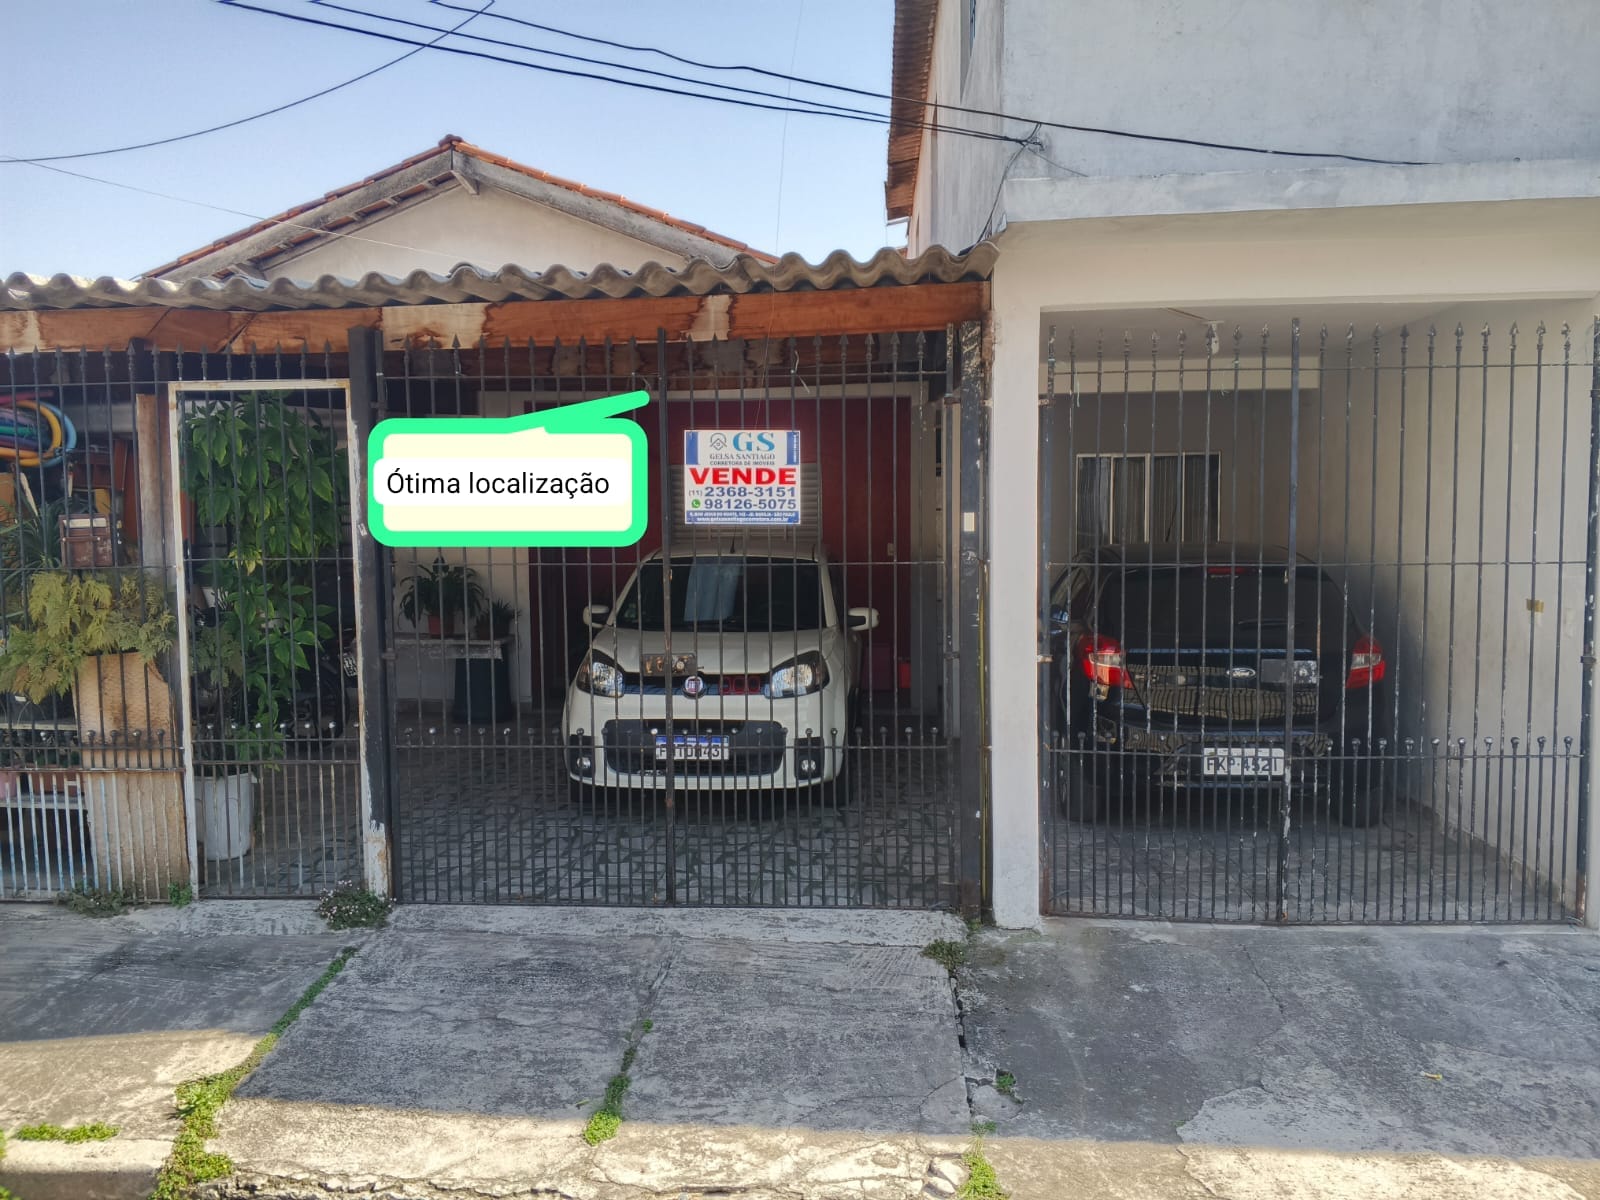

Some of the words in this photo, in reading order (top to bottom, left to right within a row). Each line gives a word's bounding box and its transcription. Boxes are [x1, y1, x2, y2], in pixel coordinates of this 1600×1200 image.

[733, 432, 775, 452] GS
[688, 468, 797, 485] VENDE
[704, 486, 796, 497] 2368-3151
[704, 499, 797, 510] 98126-5075
